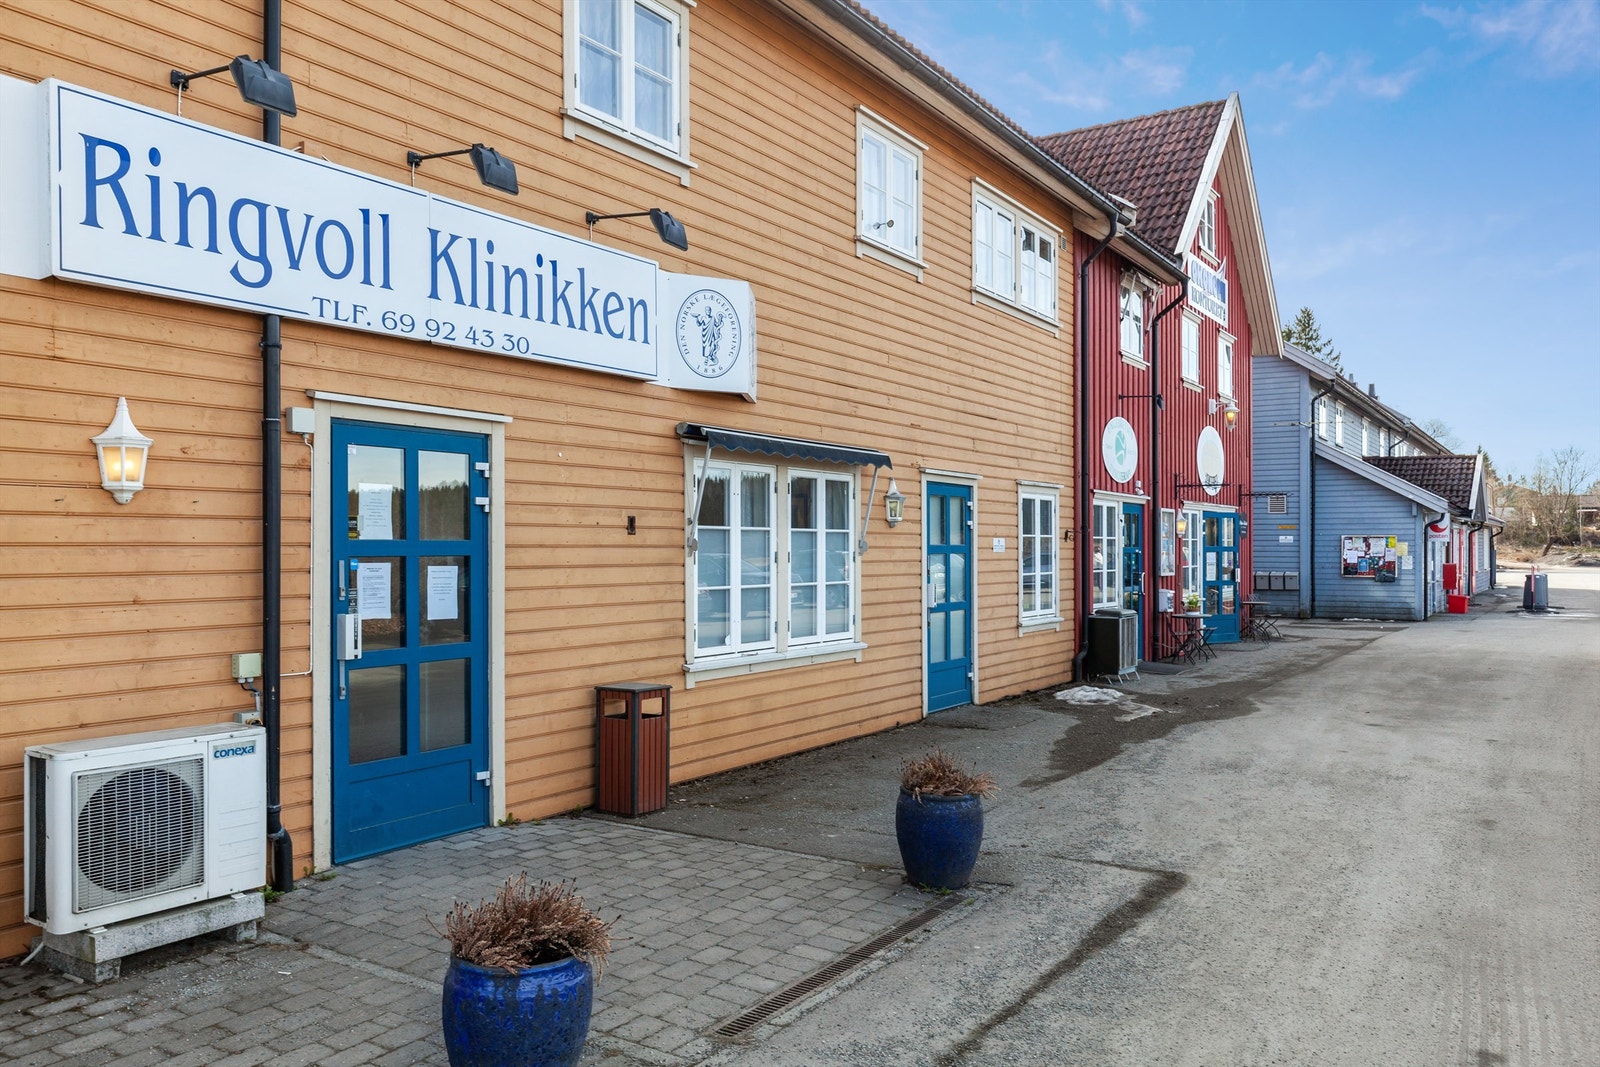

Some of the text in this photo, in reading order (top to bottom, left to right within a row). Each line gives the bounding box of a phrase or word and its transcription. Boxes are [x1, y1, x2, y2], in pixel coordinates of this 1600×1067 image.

[82, 133, 393, 290] Ringvoll
[428, 227, 650, 345] Klinikken
[312, 296, 530, 354] TLF. 69 92 43 30
[680, 295, 701, 331] NORSKE
[680, 335, 690, 355] DEN
[696, 364, 724, 374] 1886
[213, 744, 255, 759] conexa
